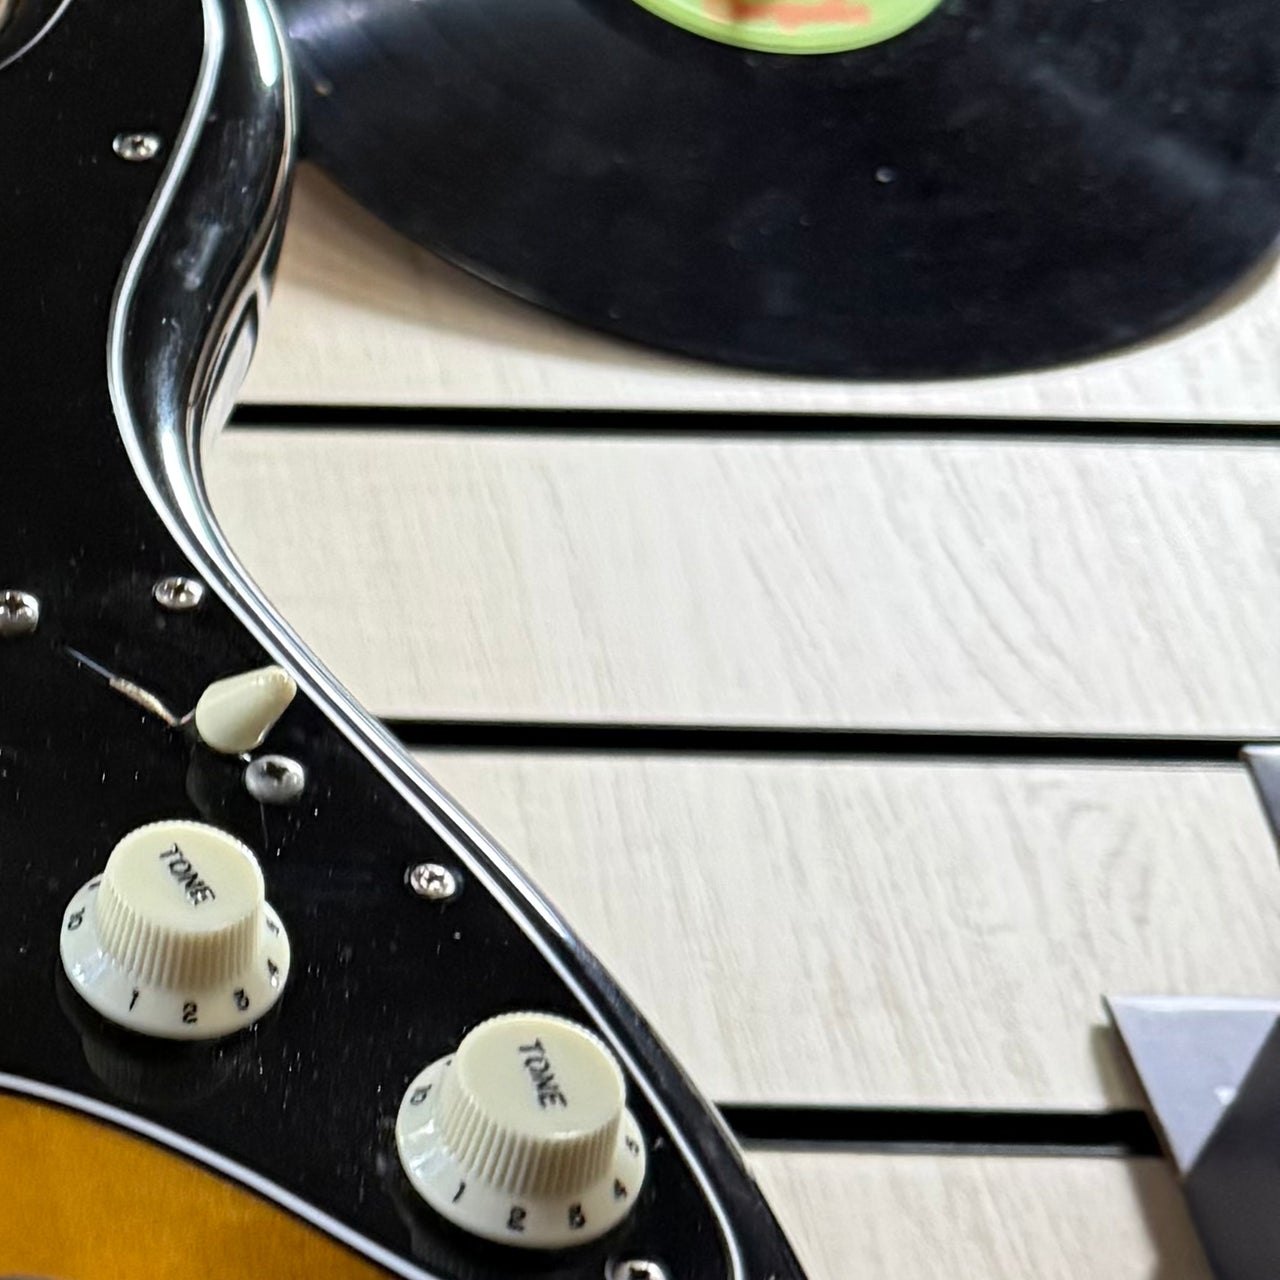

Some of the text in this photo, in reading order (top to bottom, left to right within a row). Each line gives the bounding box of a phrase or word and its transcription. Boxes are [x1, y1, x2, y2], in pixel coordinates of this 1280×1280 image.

[158, 842, 216, 907] TONE
[128, 987, 140, 1012] 1
[182, 1000, 198, 1024] 2
[518, 1037, 568, 1110] TONE
